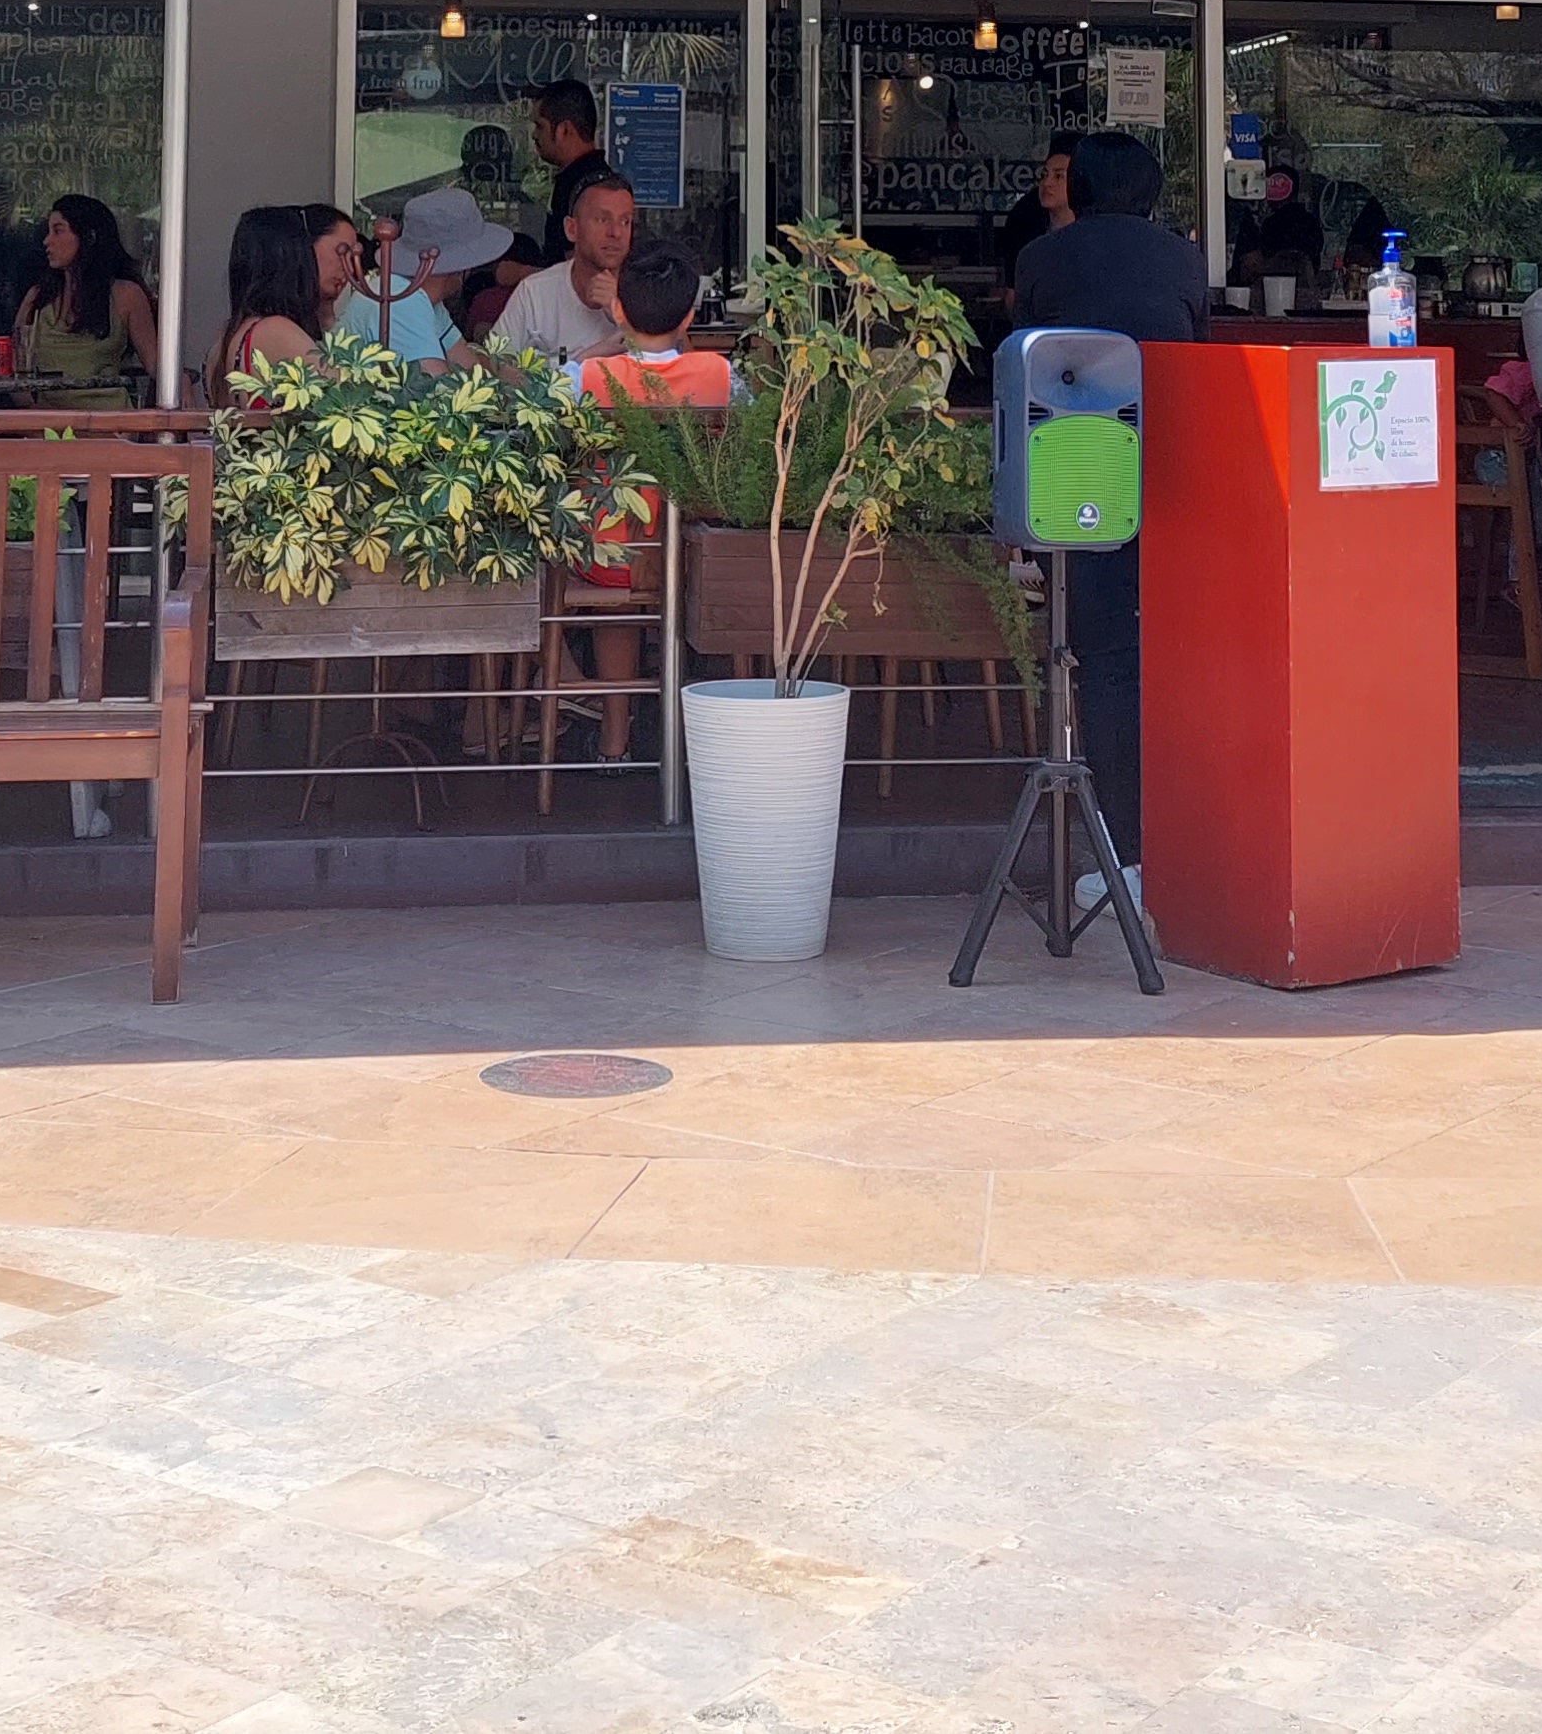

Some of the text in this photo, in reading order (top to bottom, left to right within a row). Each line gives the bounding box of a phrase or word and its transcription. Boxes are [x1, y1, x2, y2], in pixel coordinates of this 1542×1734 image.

[428, 13, 558, 45] ptatoes
[1000, 26, 1085, 61] offee
[941, 54, 1034, 82] sausage
[1234, 133, 1257, 143] VISA
